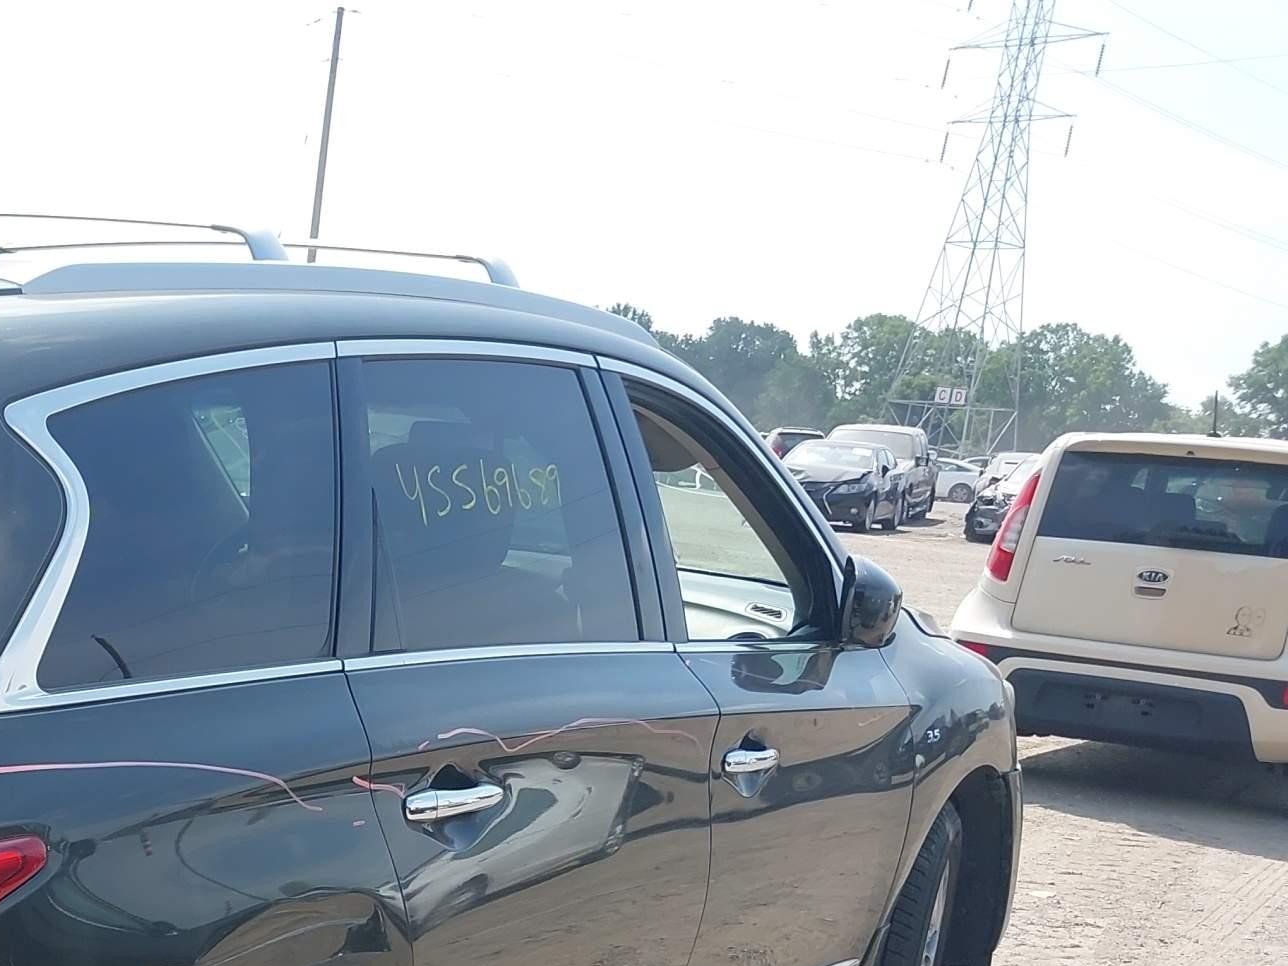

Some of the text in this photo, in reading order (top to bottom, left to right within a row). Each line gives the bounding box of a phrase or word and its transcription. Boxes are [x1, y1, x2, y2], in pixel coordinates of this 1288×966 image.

[938, 389, 963, 402] C D
[1142, 571, 1166, 582] KIA
